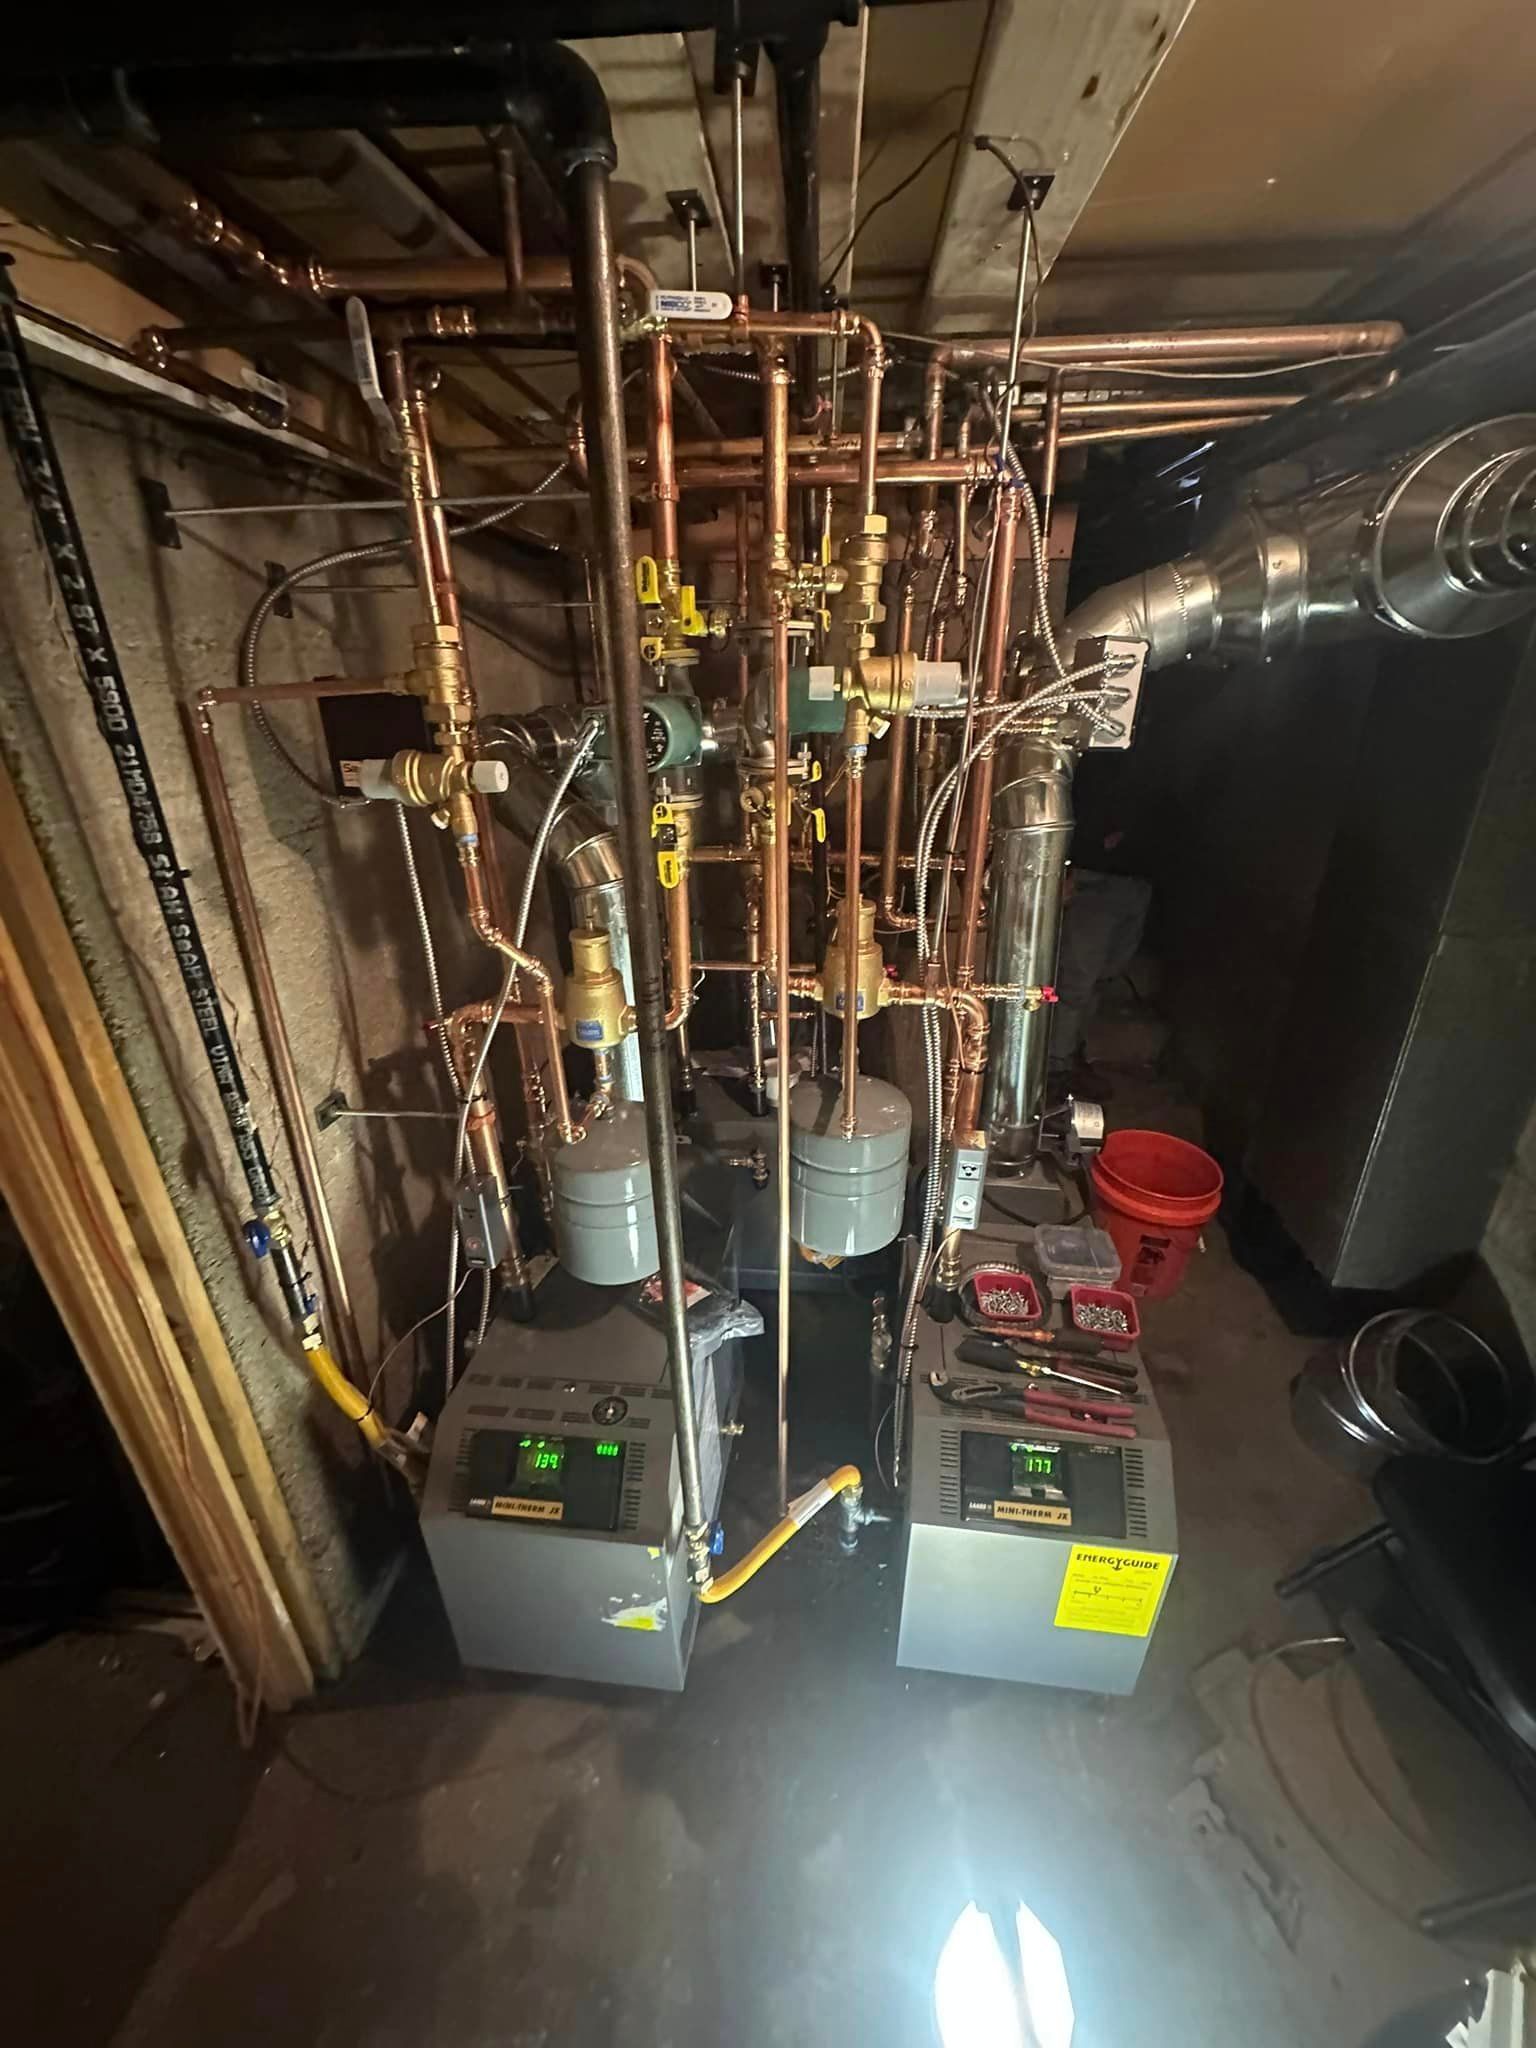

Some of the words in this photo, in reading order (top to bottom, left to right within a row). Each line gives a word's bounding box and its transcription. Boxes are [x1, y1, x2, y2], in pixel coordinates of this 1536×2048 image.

[94, 675, 128, 732] 5900
[190, 987, 220, 1034] STEEL
[535, 1453, 559, 1469] 139
[1027, 1459, 1051, 1474] 177
[997, 1506, 1052, 1518] MINI-THERM
[1057, 1512, 1068, 1520] JX
[1076, 1553, 1160, 1571] ENERGYGUIDE
